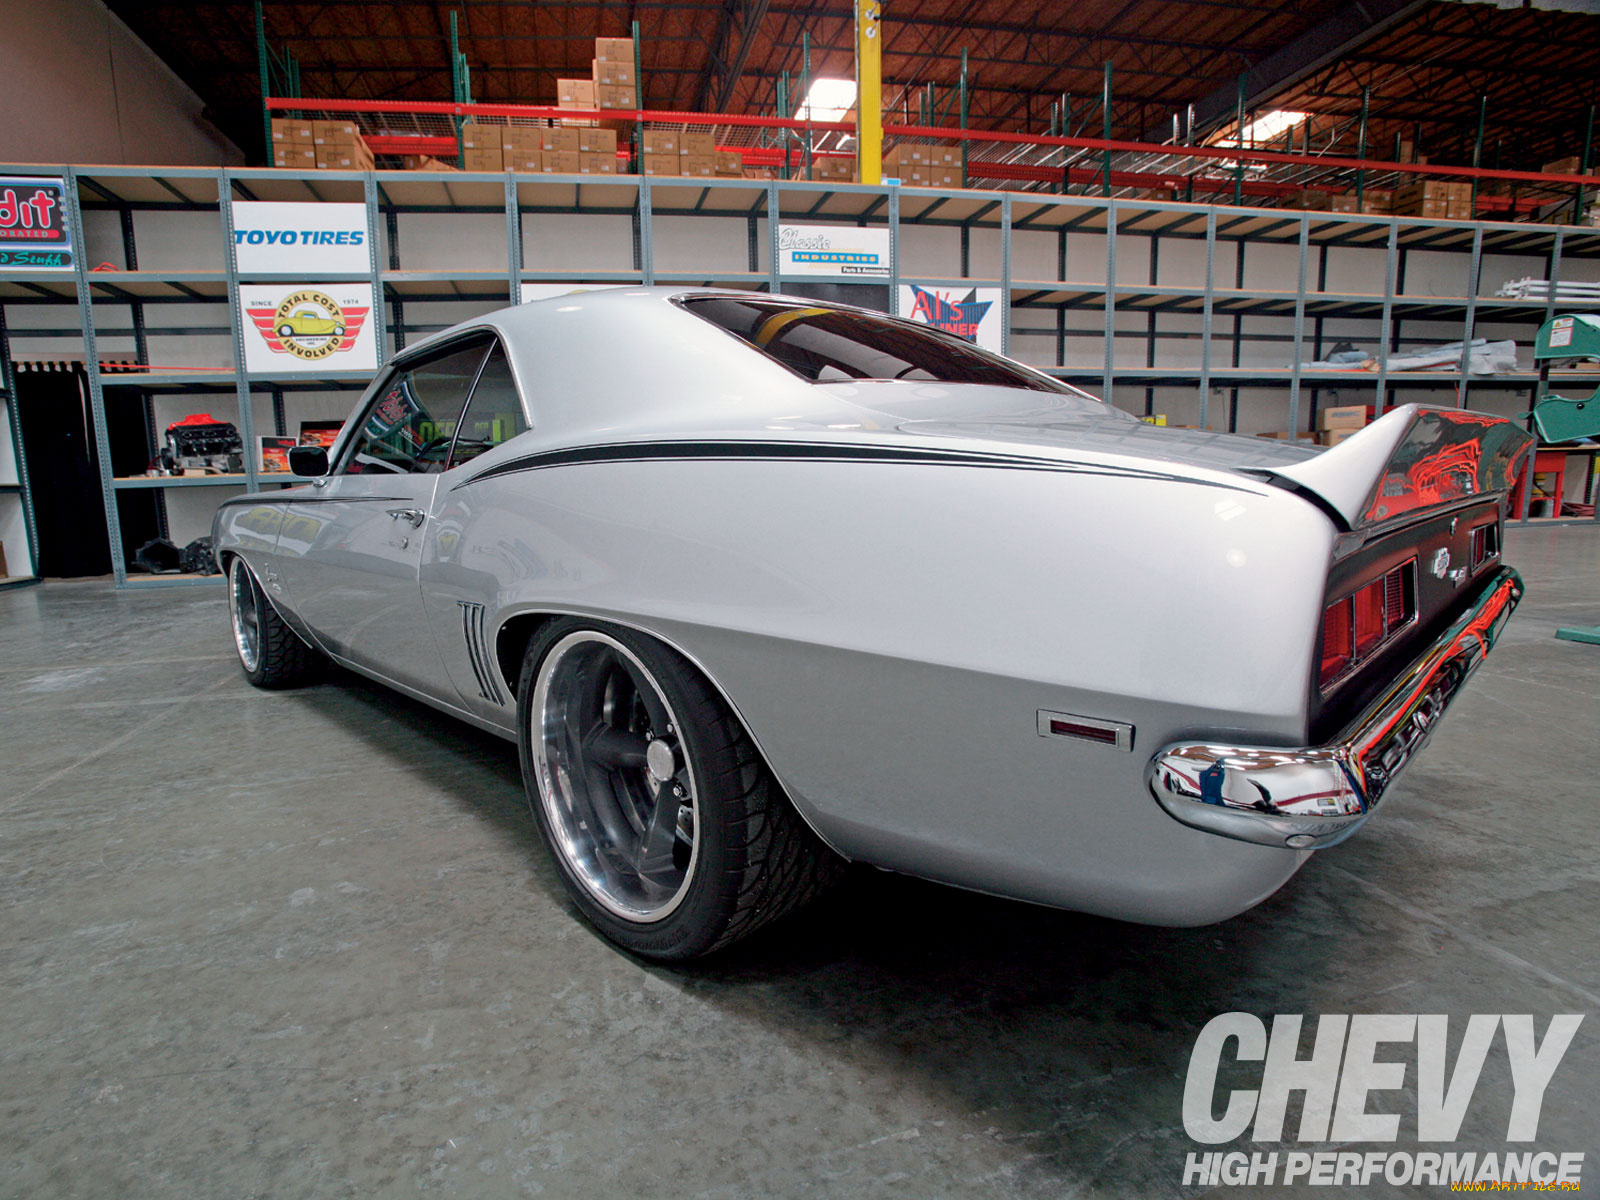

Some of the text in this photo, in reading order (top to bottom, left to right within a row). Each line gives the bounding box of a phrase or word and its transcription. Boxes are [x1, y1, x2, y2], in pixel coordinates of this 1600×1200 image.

[234, 230, 364, 245] TOYO TIRES
[779, 228, 831, 250] Classic
[10, 251, 62, 267] Stuff
[794, 254, 877, 262] INDUSTRIES
[278, 293, 340, 319] TOTAL COST
[910, 291, 963, 321] Al's
[930, 323, 979, 336] NER
[283, 337, 340, 358] INVOLVED
